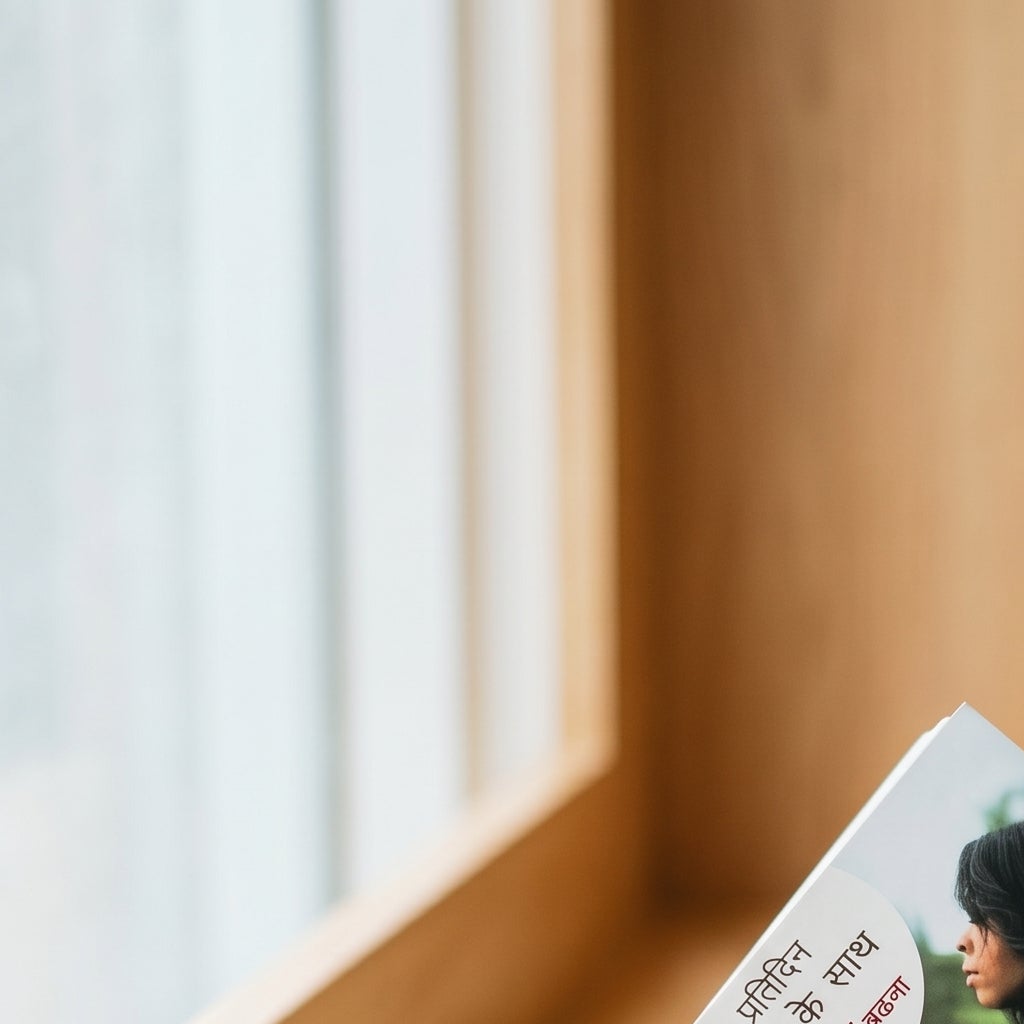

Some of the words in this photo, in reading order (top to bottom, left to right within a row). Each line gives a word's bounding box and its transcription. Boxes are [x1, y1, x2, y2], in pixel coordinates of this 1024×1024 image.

[735, 939, 813, 1024] प्रतिदिन
[784, 991, 824, 1024] के
[822, 930, 880, 986] साथ
